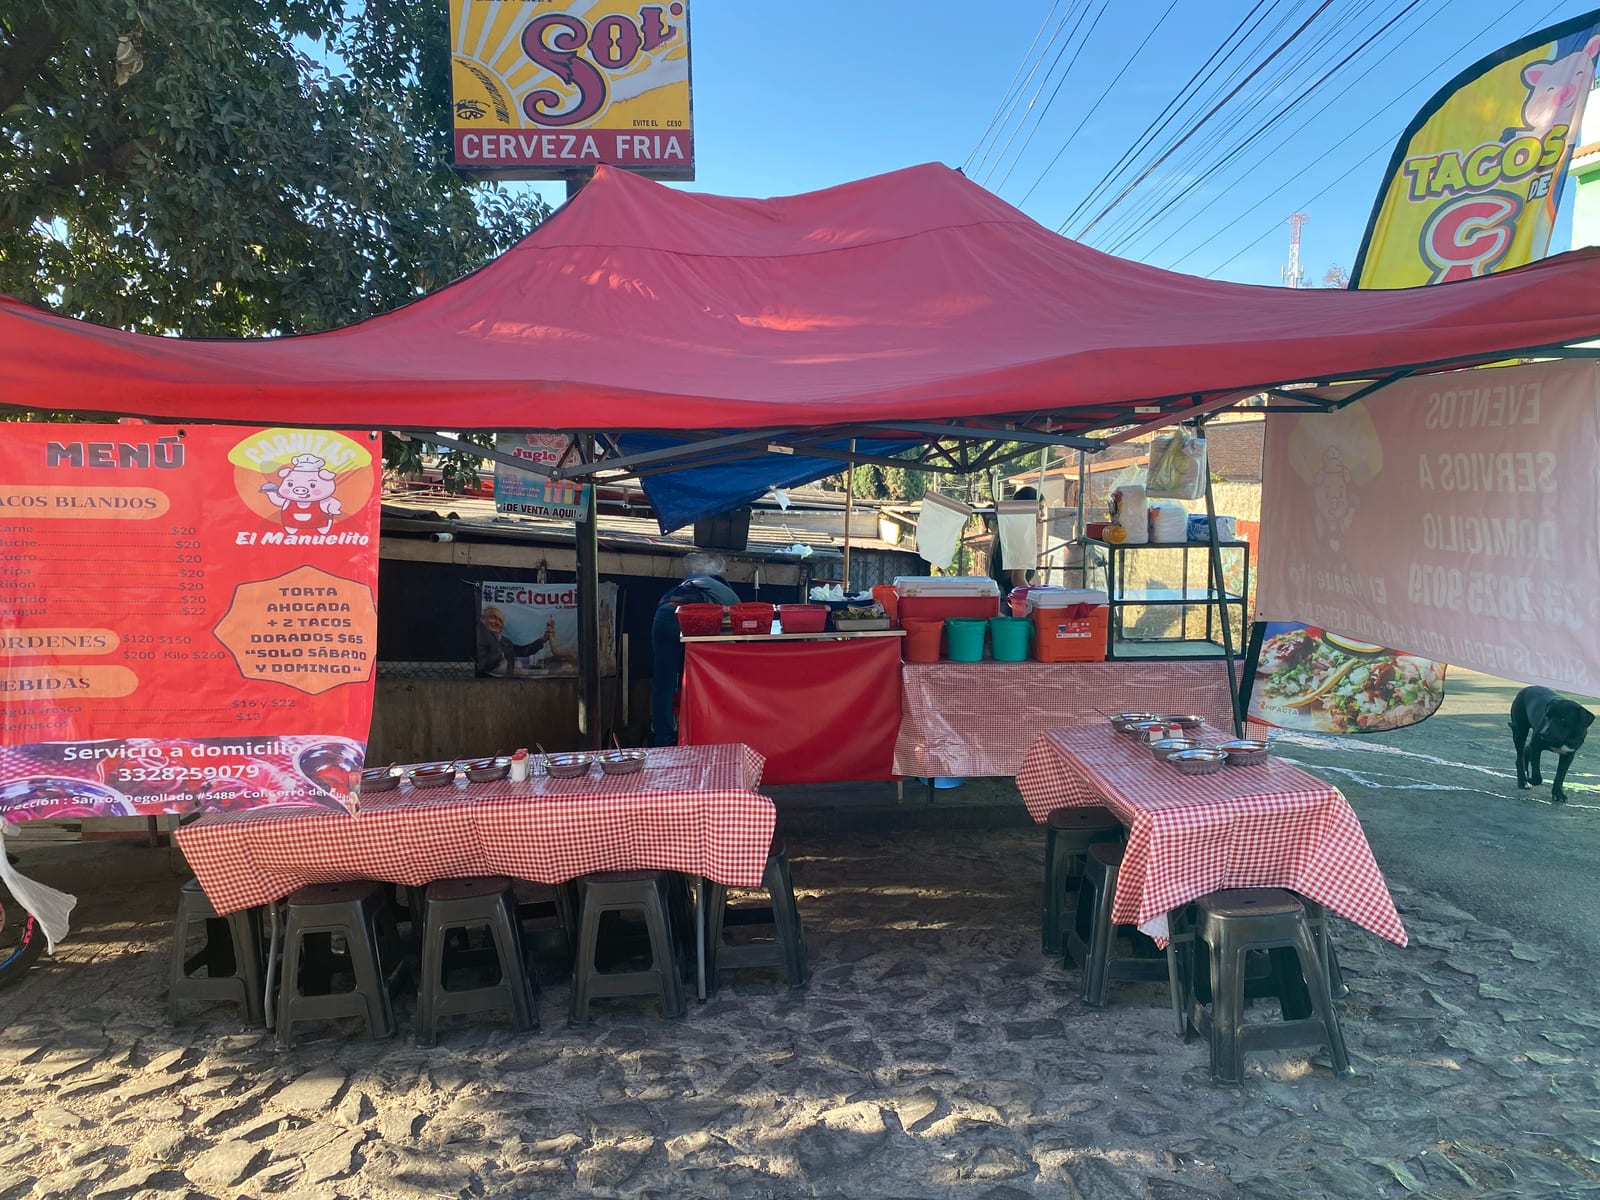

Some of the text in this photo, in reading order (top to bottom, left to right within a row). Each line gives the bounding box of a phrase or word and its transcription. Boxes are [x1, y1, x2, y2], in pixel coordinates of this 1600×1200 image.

[633, 119, 650, 127] EVITE
[651, 119, 658, 127] EL
[462, 134, 684, 159] CERVEZA FRIA
[1404, 124, 1569, 199] TACOS
[1528, 176, 1550, 200] DE
[46, 436, 185, 469] MENÚ
[55, 496, 157, 509] BLANDOS
[521, 505, 549, 515] VENTA
[171, 527, 197, 535] $20
[235, 531, 369, 545] El Manuelito
[175, 540, 201, 549] $20
[177, 554, 202, 563] $20
[180, 569, 204, 577] $20
[179, 582, 204, 591] $20
[279, 587, 338, 597] TORTA
[181, 595, 206, 604] $20
[483, 589, 577, 605] #EsClaudi
[0, 607, 207, 616] engua $22
[267, 603, 350, 612] AHOGADA
[267, 618, 352, 627] + 2 TACOS
[123, 634, 154, 643] $120
[159, 635, 192, 644] $150
[251, 633, 363, 645] DORADOS $65
[123, 651, 226, 660] $200 Kilo $260
[255, 664, 267, 673] Y
[231, 699, 256, 708] $16
[271, 699, 296, 708] $22
[236, 712, 260, 720] $13
[63, 742, 300, 760] Servicio a domicilio
[118, 765, 259, 781] 3328259079
[72, 794, 120, 805] Santos
[124, 792, 193, 804] Degollado
[198, 792, 236, 800] #5488
[308, 788, 326, 797] del
